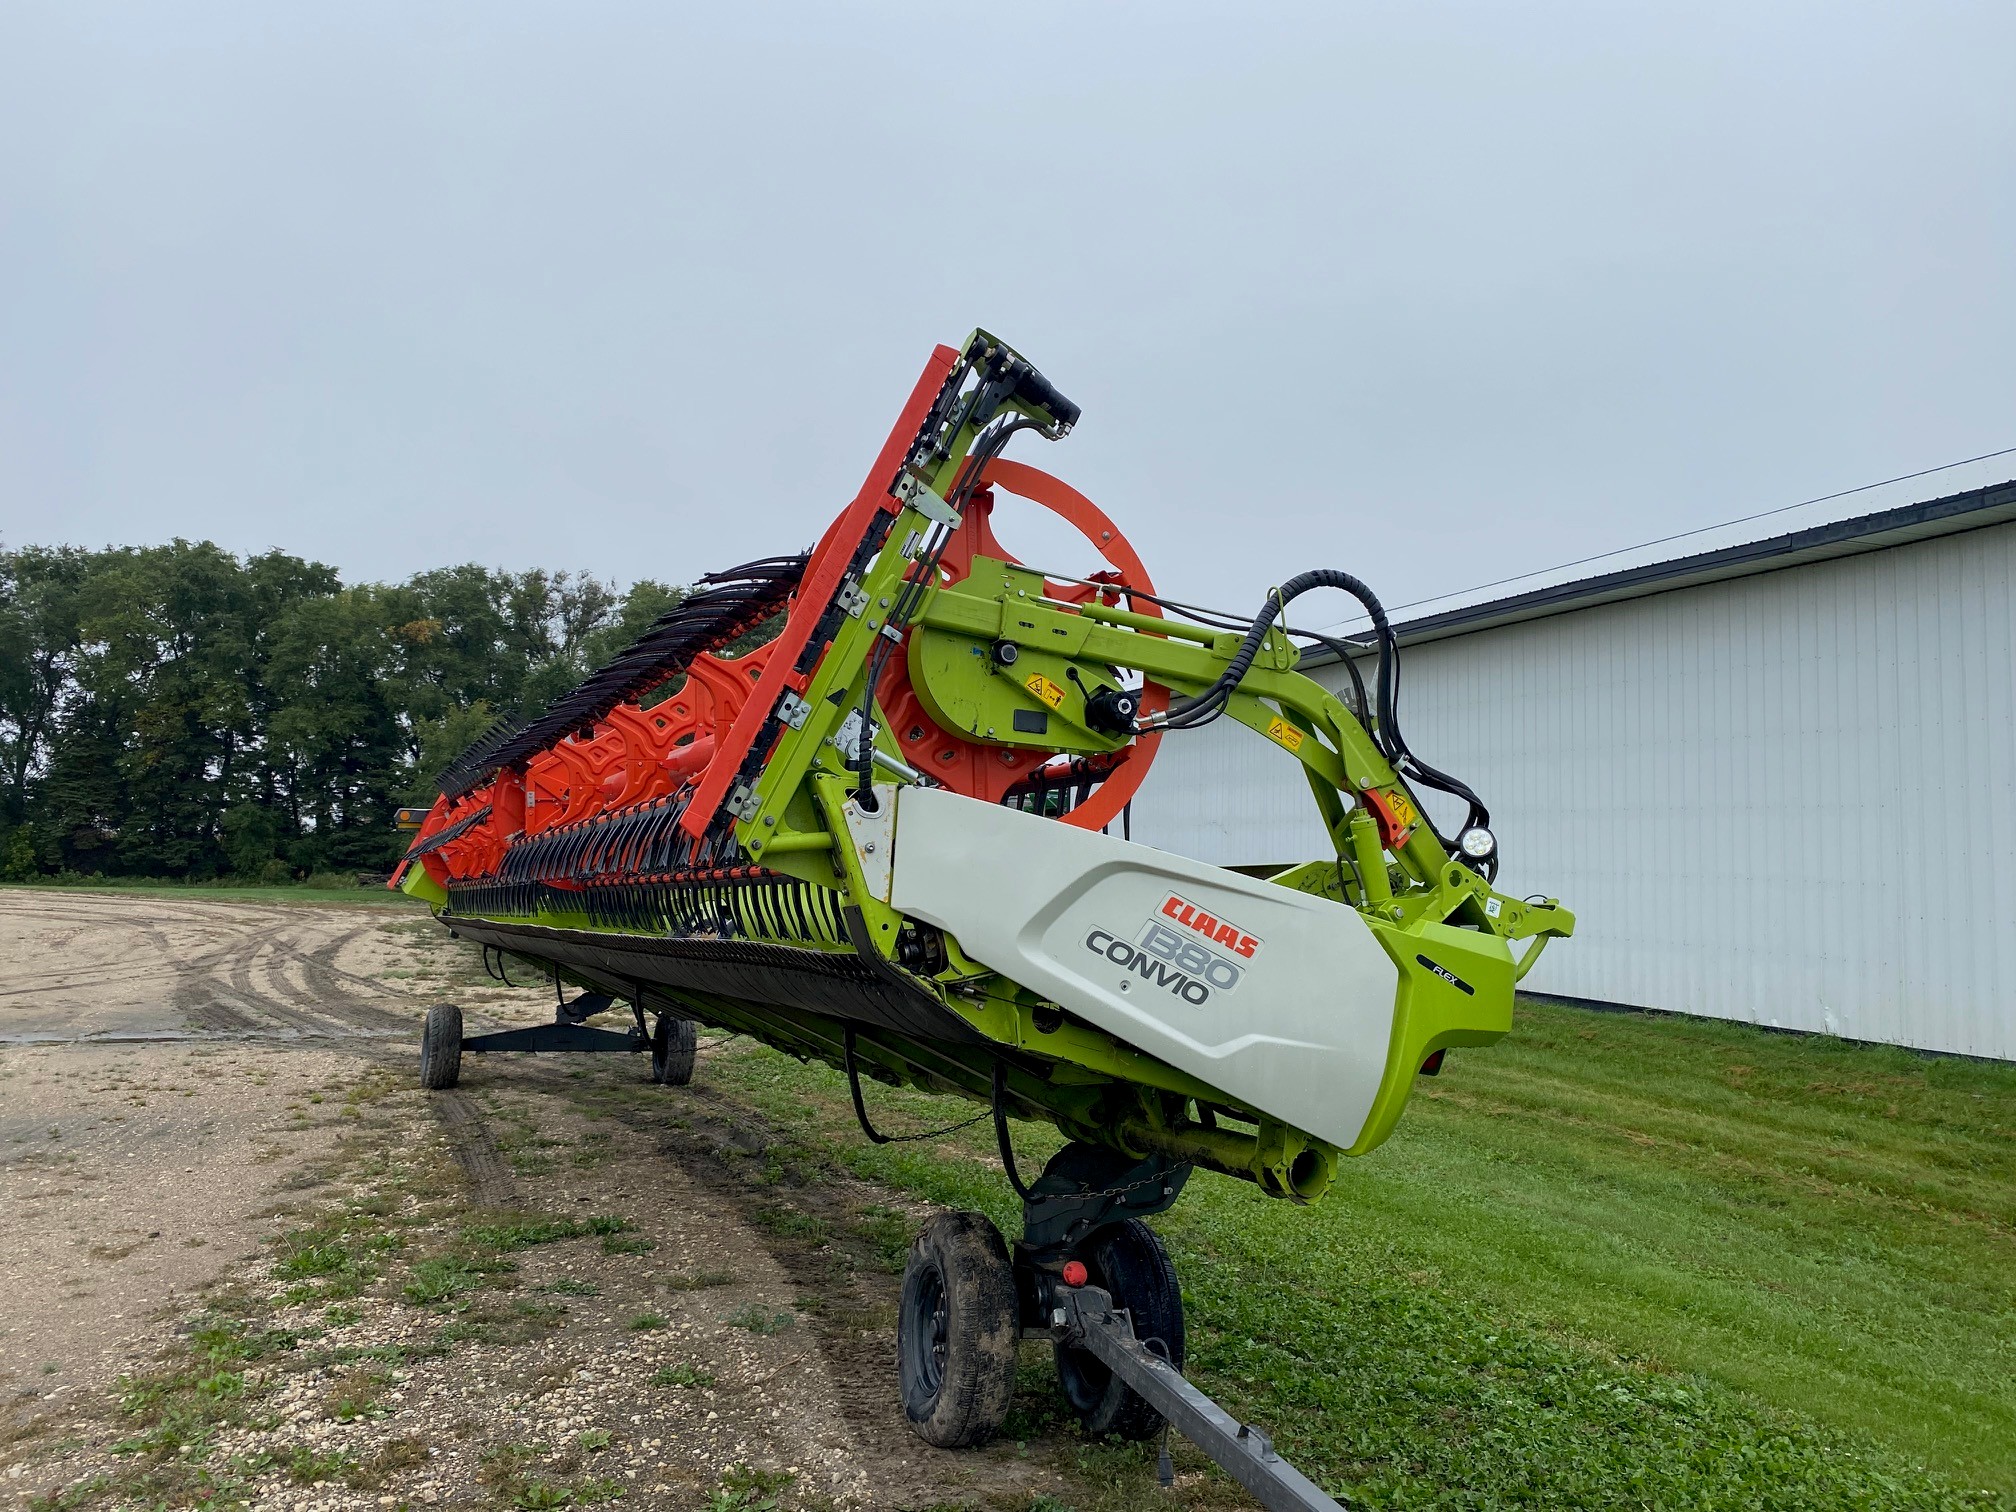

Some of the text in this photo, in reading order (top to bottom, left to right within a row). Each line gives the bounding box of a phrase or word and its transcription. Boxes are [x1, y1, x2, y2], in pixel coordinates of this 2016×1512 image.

[1161, 896, 1259, 959] CLAAS
[1085, 930, 1210, 1006] CONVIO
[1432, 965, 1458, 985] FLEX
